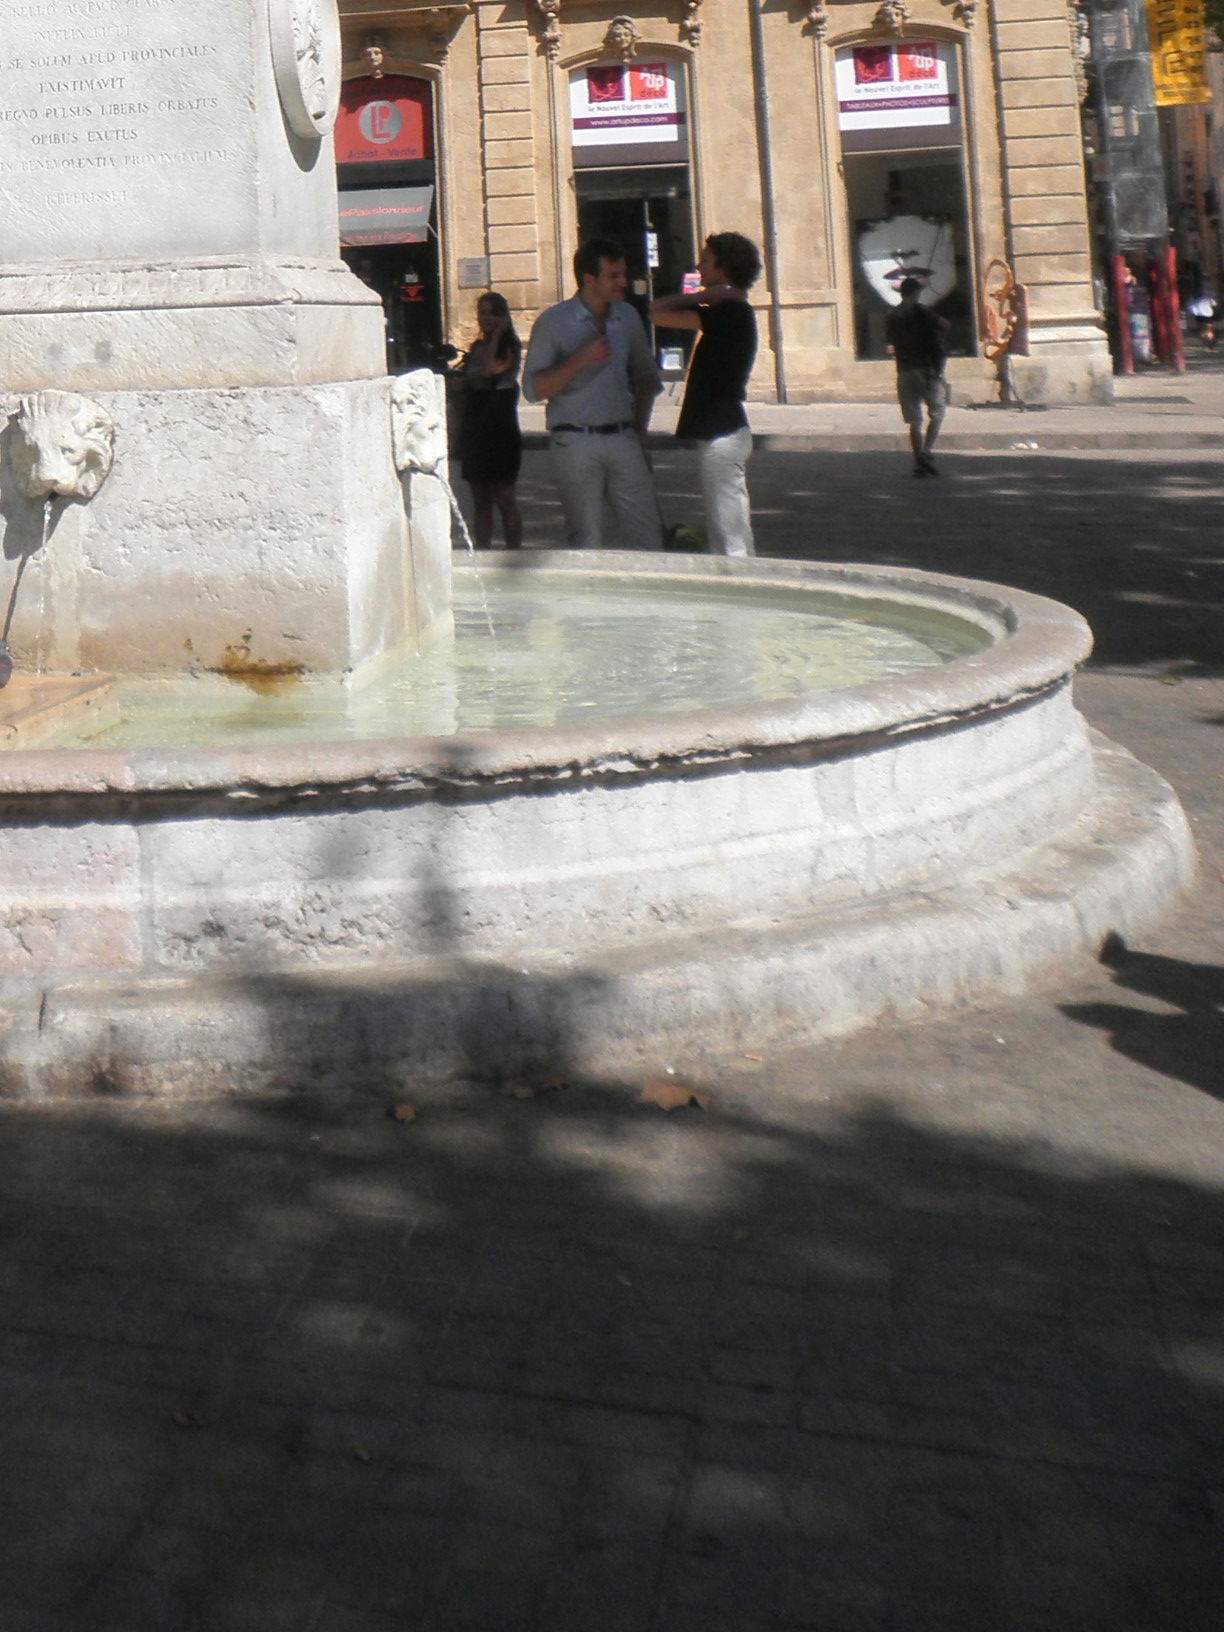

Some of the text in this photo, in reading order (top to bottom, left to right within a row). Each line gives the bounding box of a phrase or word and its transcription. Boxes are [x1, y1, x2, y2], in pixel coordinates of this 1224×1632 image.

[8, 58, 24, 70] SE
[30, 55, 72, 69] SOLUM
[80, 50, 116, 64] APUD
[122, 45, 217, 63] PROVINCIALES
[915, 57, 934, 71] up
[39, 77, 126, 94] EXISTIMAVIT
[645, 78, 665, 91] up
[46, 105, 92, 119] PULSUS
[101, 102, 149, 116] LIBERIS
[158, 97, 217, 113] ORBATUS
[32, 128, 138, 146] OPIBUS EXUTUS
